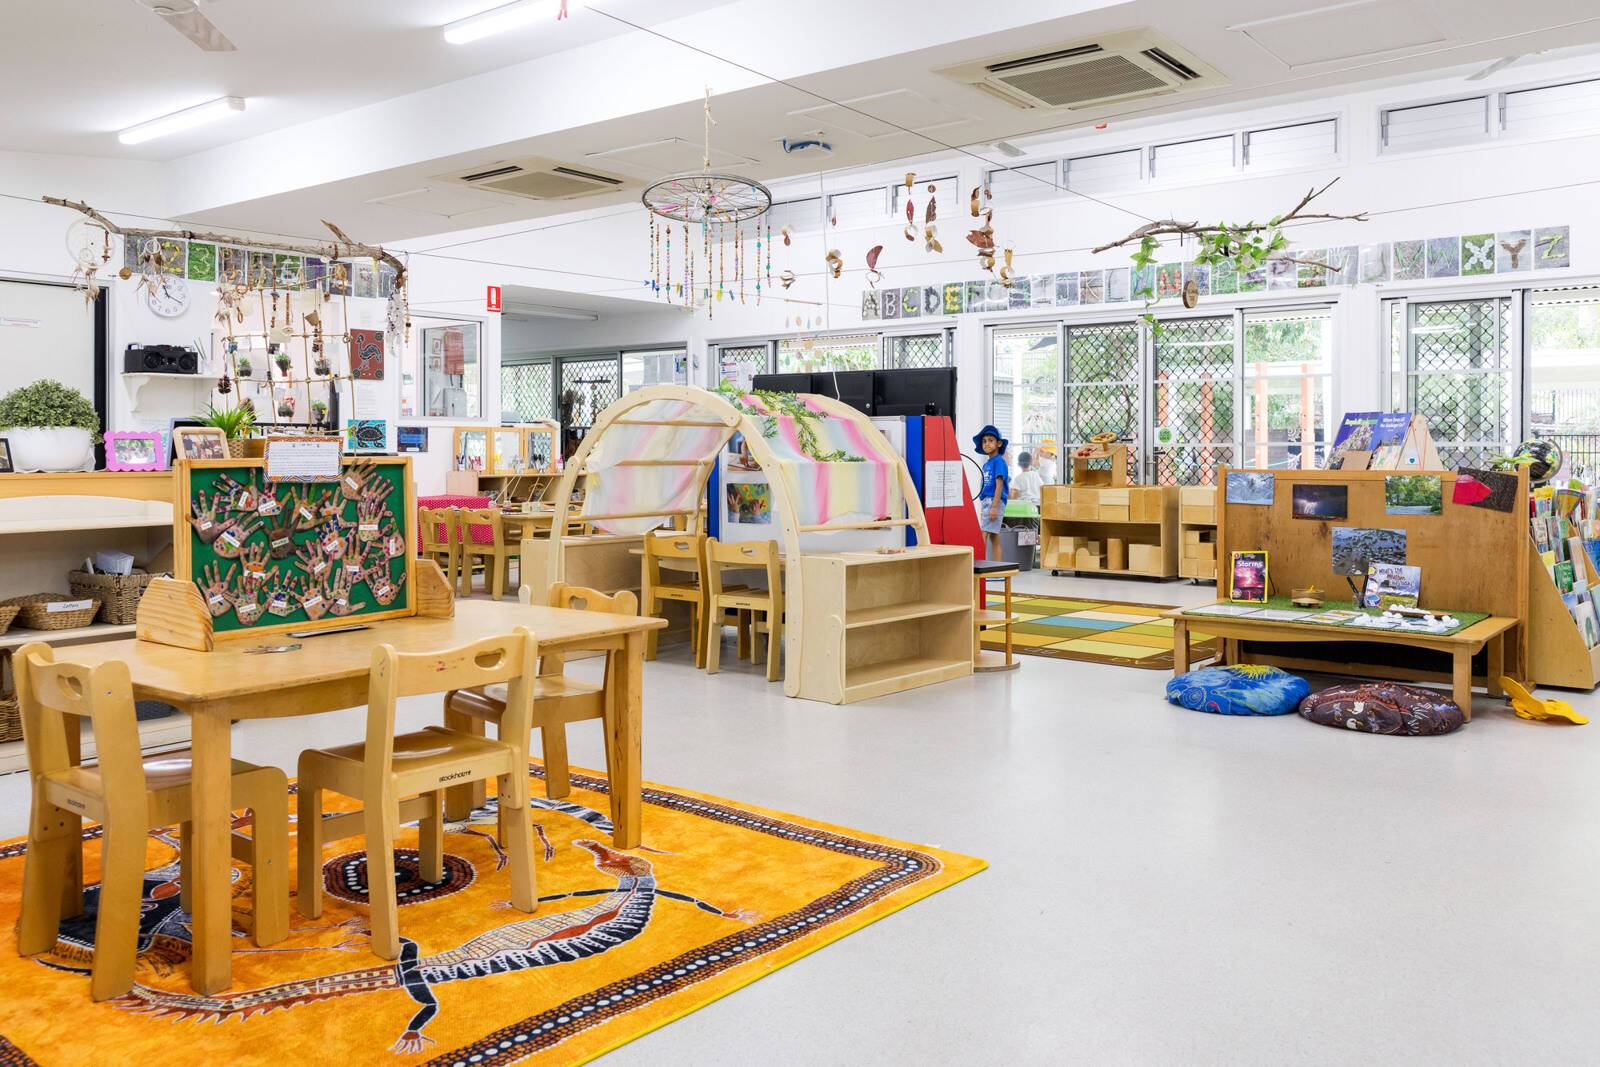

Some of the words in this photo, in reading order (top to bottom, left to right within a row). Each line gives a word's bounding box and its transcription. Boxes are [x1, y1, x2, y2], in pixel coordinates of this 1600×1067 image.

[192, 246, 211, 275] 3
[863, 292, 880, 316] A
[885, 291, 896, 316] B
[903, 288, 918, 313] C
[924, 286, 941, 314] D
[946, 285, 960, 311] E
[1465, 239, 1494, 270] X
[1500, 239, 1526, 269] Y
[1540, 234, 1566, 260] Z
[1236, 560, 1264, 568] Storms
